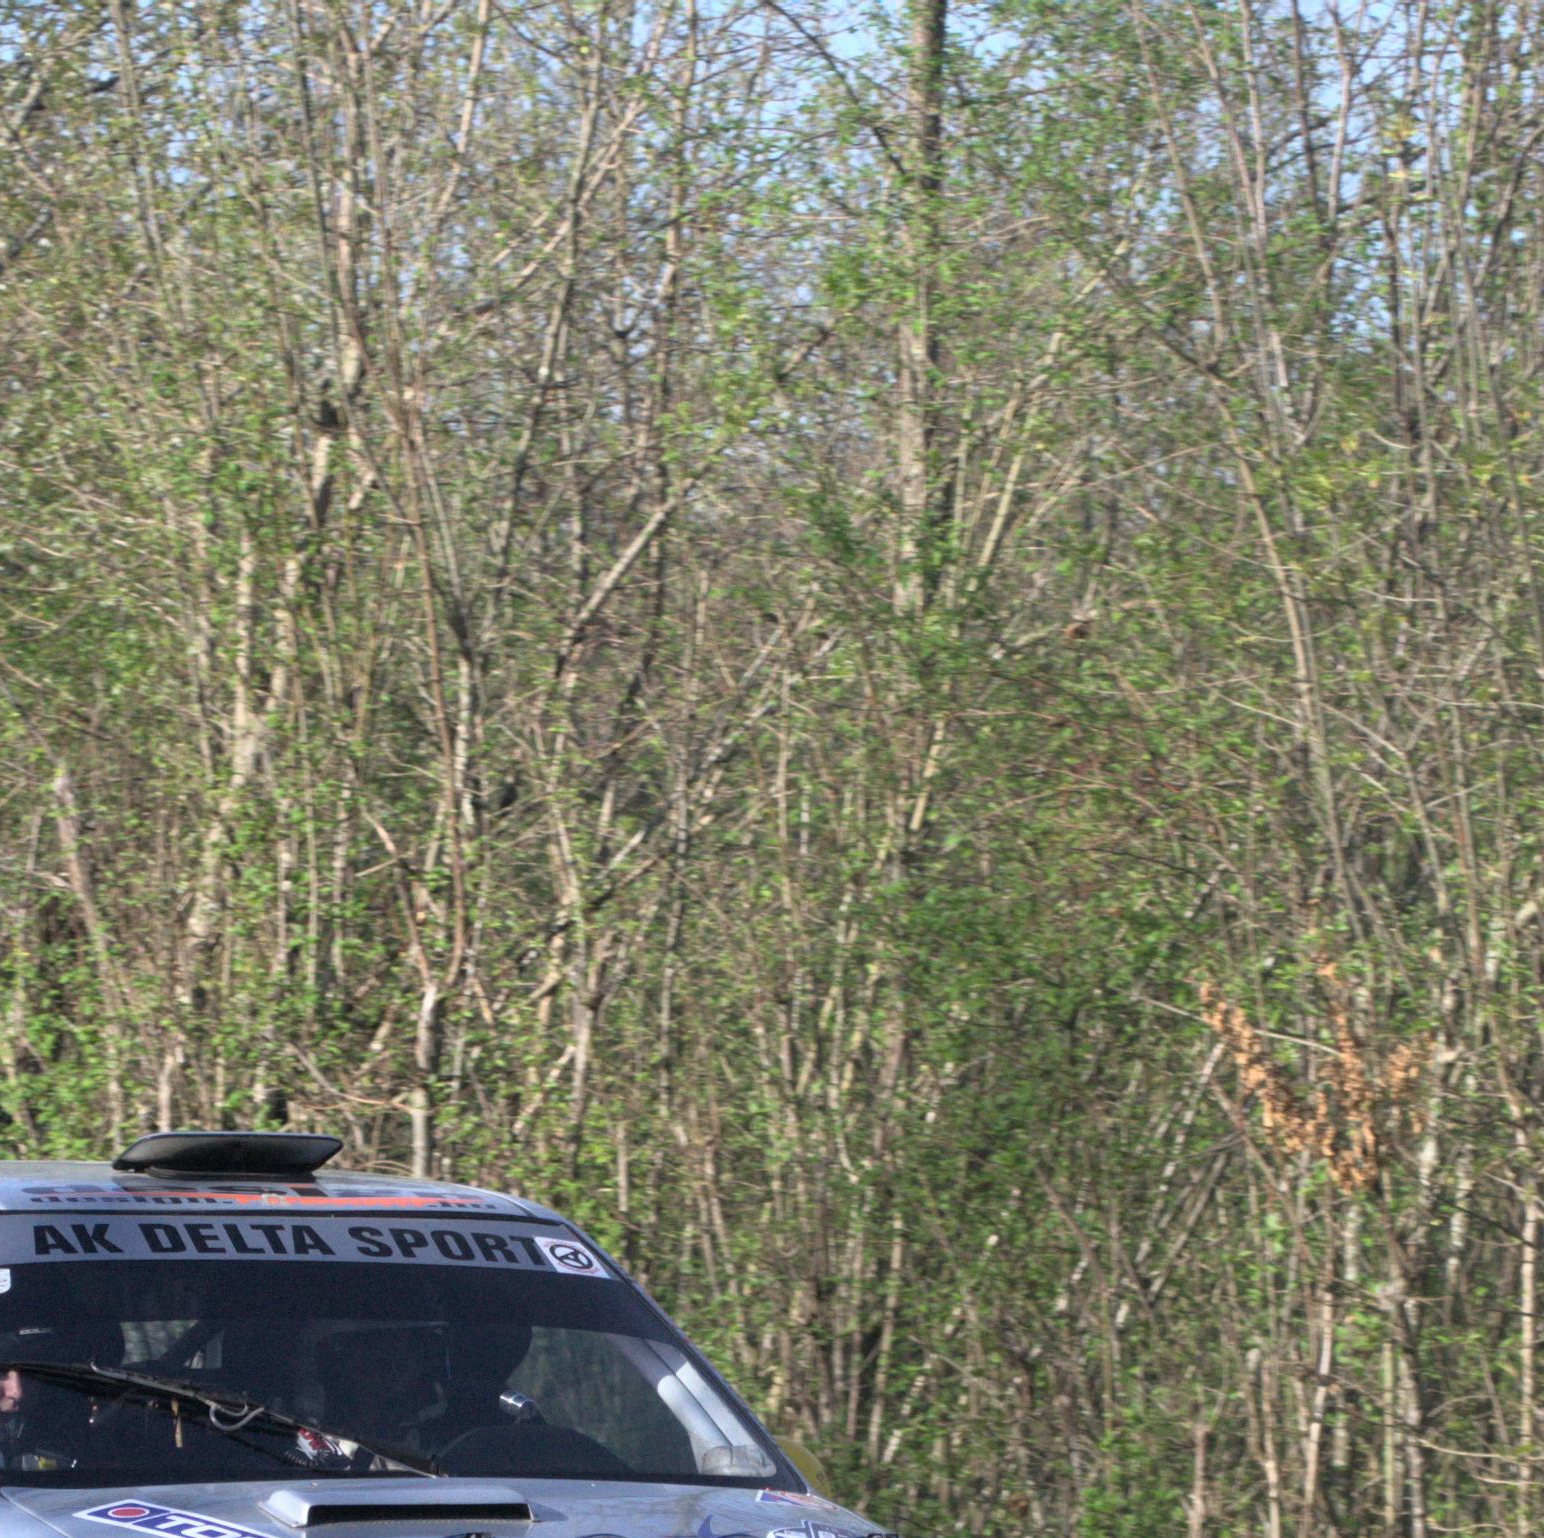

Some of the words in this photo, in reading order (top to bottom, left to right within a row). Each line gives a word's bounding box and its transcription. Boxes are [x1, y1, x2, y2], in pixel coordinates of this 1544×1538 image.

[33, 1222, 125, 1256] AK
[138, 1222, 336, 1257] DELTA
[353, 1228, 546, 1266] SPORT
